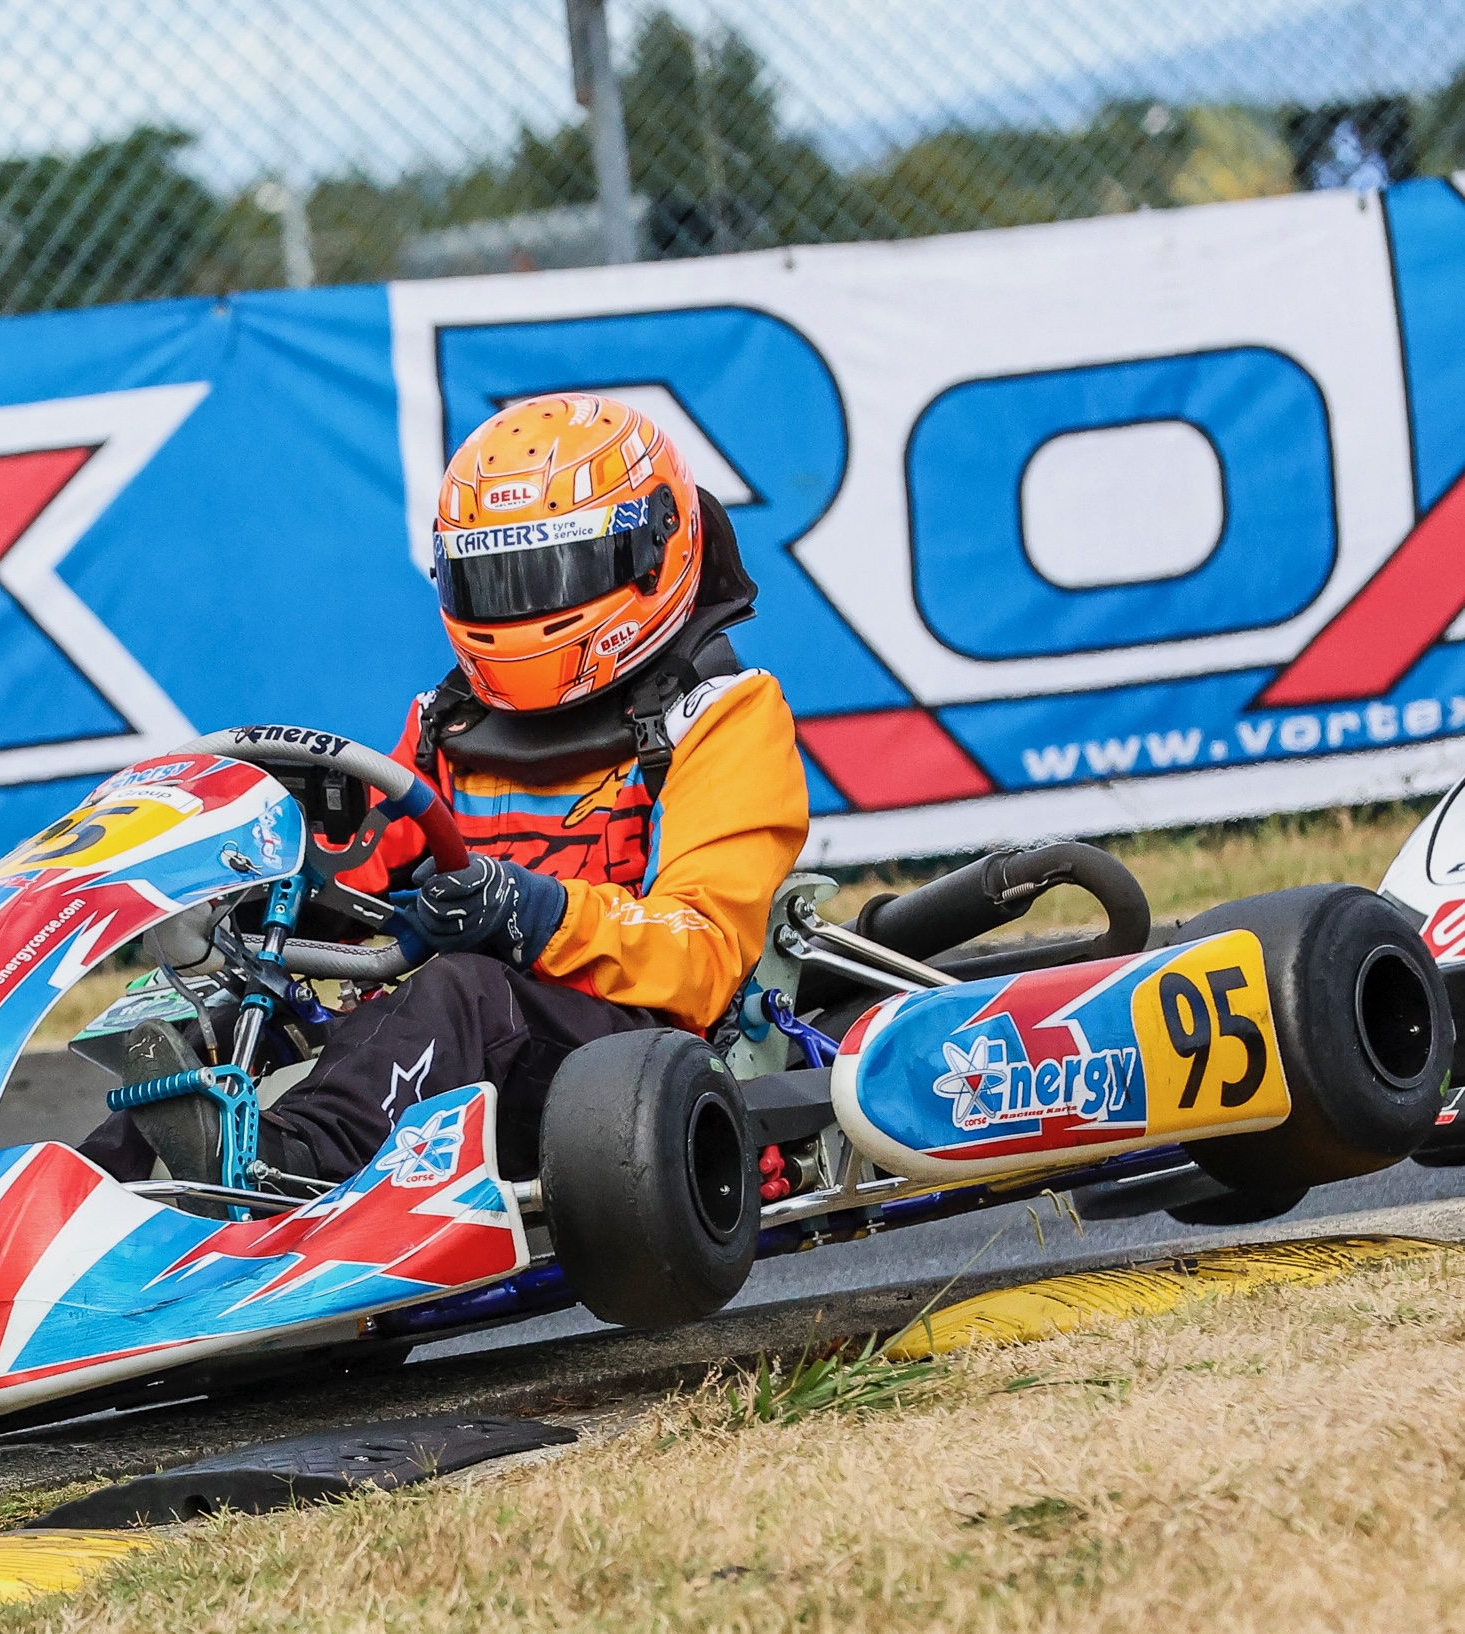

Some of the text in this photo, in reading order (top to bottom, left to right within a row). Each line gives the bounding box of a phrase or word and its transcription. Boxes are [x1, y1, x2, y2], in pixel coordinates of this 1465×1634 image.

[490, 488, 532, 504] BELL
[553, 521, 576, 531] tyre
[554, 527, 594, 540] service
[456, 523, 549, 555] CARTER'S
[601, 626, 634, 652] BELL
[237, 725, 350, 756] Energy
[1159, 966, 1267, 1109] 95
[959, 1045, 1133, 1115] Energy
[999, 1105, 1077, 1120] Racing Karts
[965, 1117, 987, 1127] corse
[405, 1173, 435, 1183] corse
